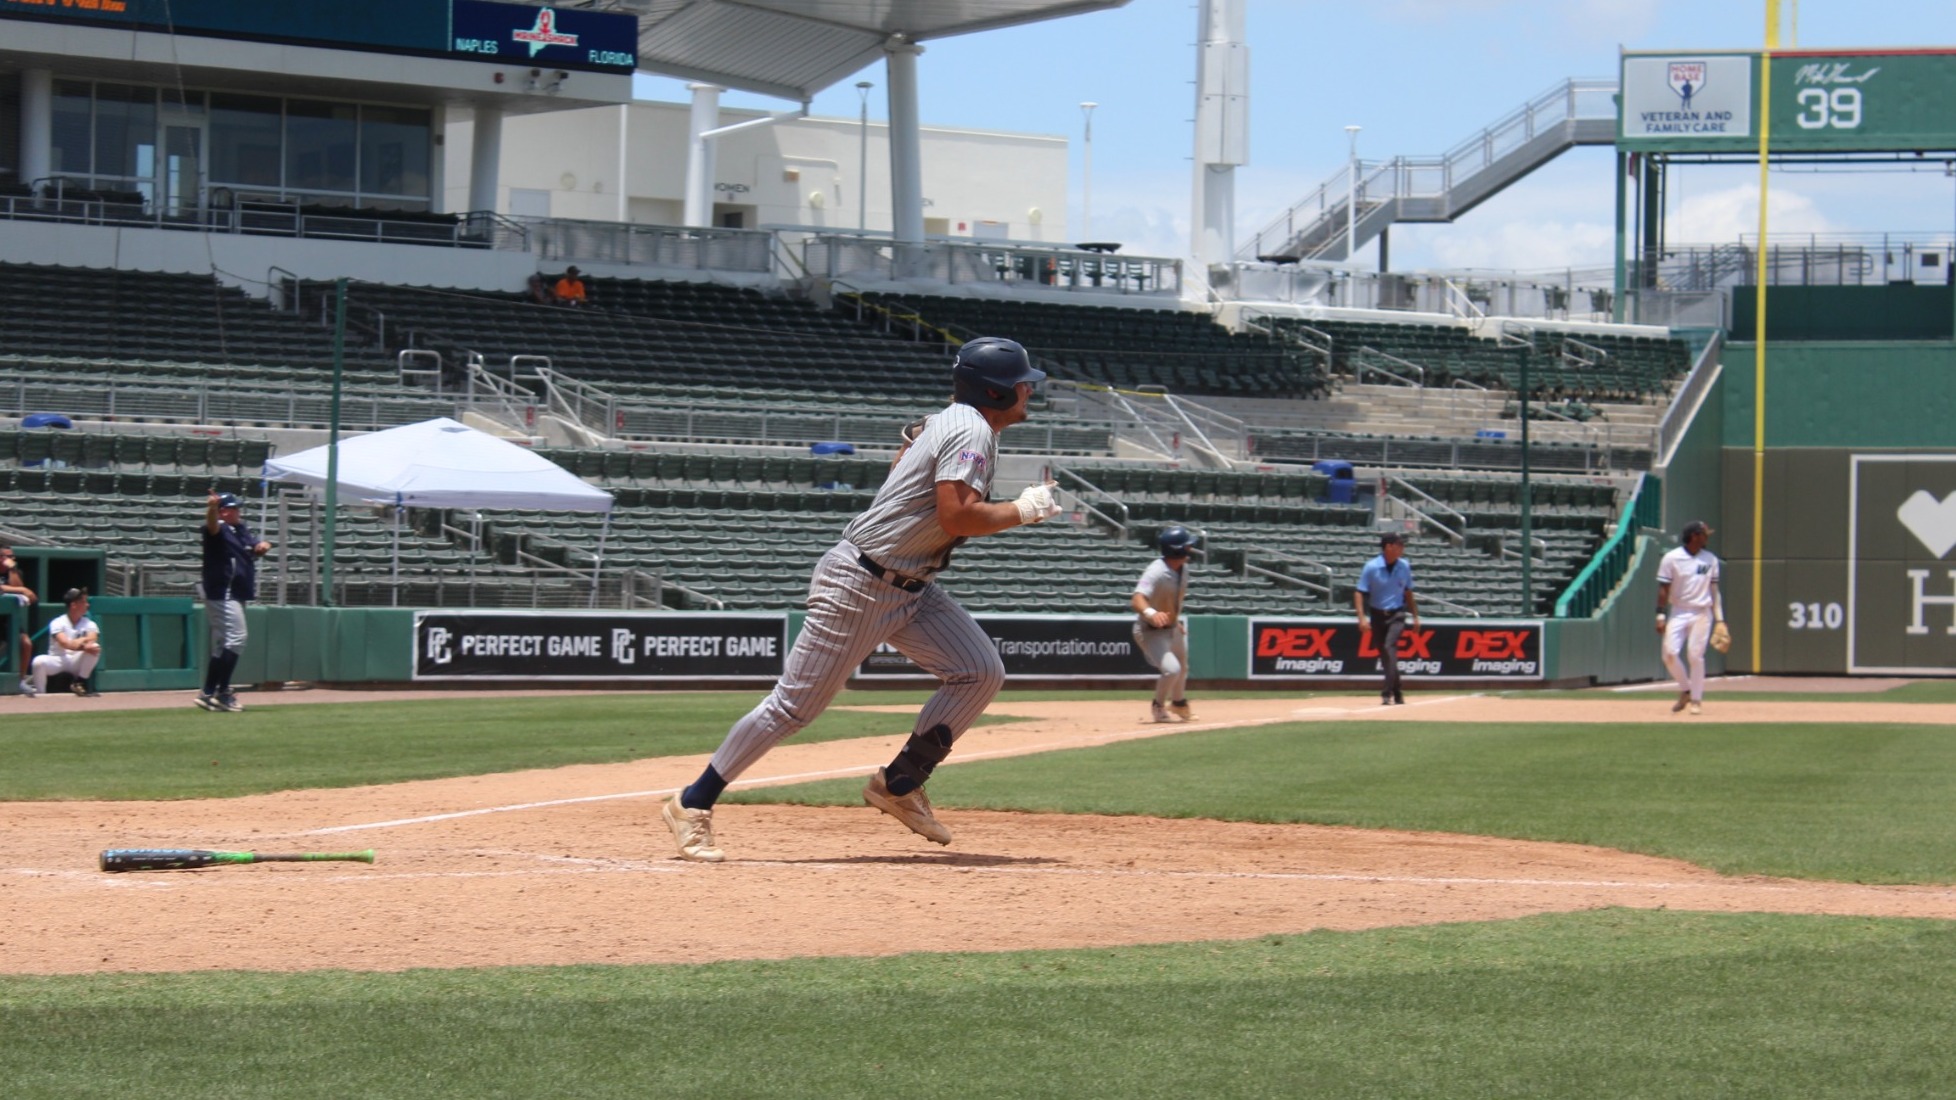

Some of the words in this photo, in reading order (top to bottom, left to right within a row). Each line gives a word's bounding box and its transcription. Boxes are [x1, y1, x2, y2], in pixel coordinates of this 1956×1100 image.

[456, 38, 499, 54] NAPLES
[589, 50, 634, 65] FLORIDA
[1671, 65, 1703, 73] HOME
[1674, 73, 1701, 82] BASE
[1641, 111, 1700, 122] VETERAN
[1704, 111, 1733, 121] AND
[1797, 88, 1862, 129] 39
[1646, 123, 1691, 133] FAMILY
[1692, 122, 1727, 133] CARE
[1788, 602, 1843, 630] 310
[461, 635, 545, 656] PERFECT
[547, 636, 602, 656] GAME
[644, 636, 722, 657] PERFECT
[726, 637, 777, 657] GAME
[1256, 628, 1337, 657] DEX
[1454, 630, 1530, 658] DEX
[1275, 657, 1344, 673] imaging
[1472, 659, 1536, 673] imaging
